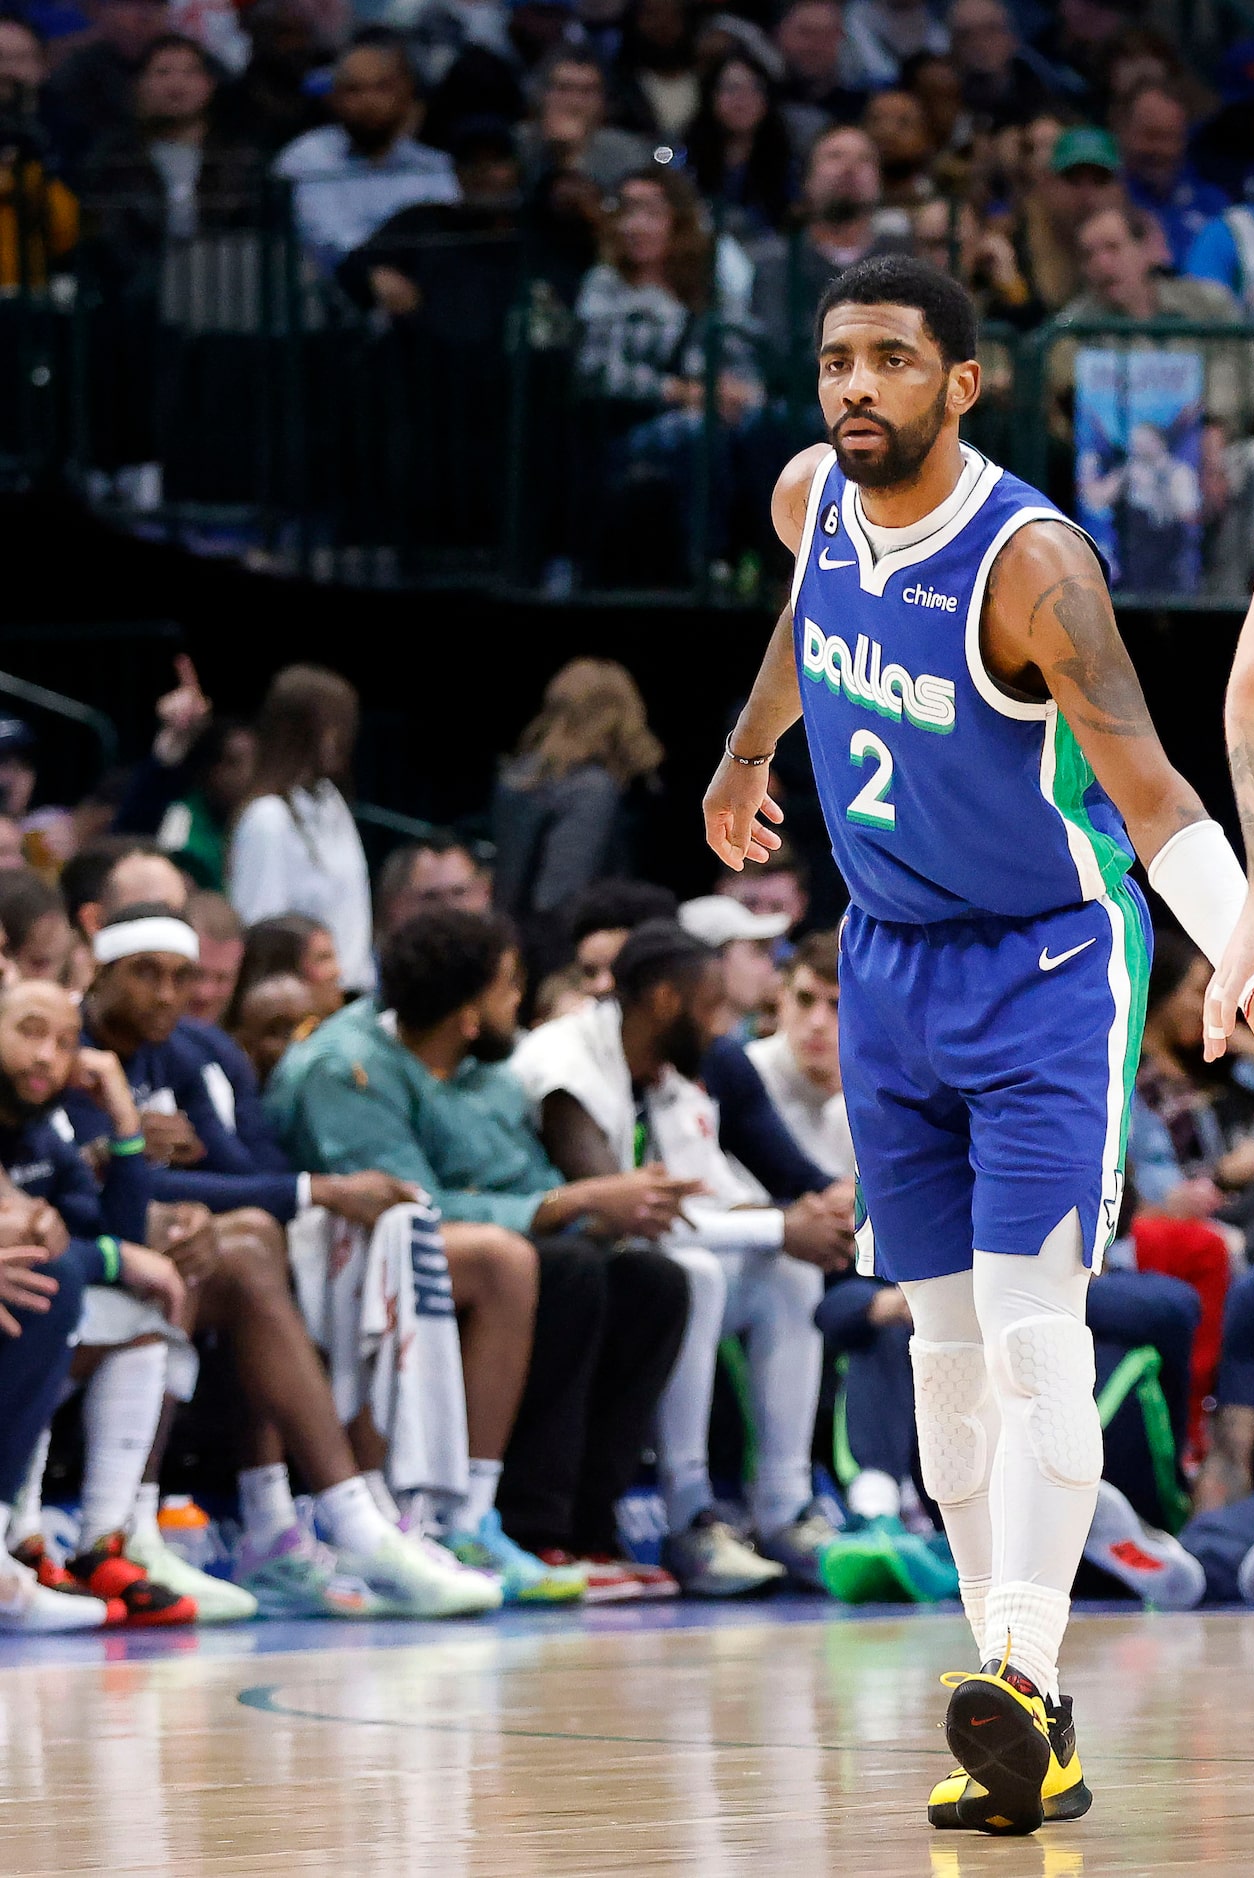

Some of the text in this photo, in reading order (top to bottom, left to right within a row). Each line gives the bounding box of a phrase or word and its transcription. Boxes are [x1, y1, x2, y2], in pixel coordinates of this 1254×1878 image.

[823, 503, 840, 536] 6
[902, 583, 957, 613] chime
[803, 616, 956, 735] Dallas
[846, 728, 896, 832] 2
